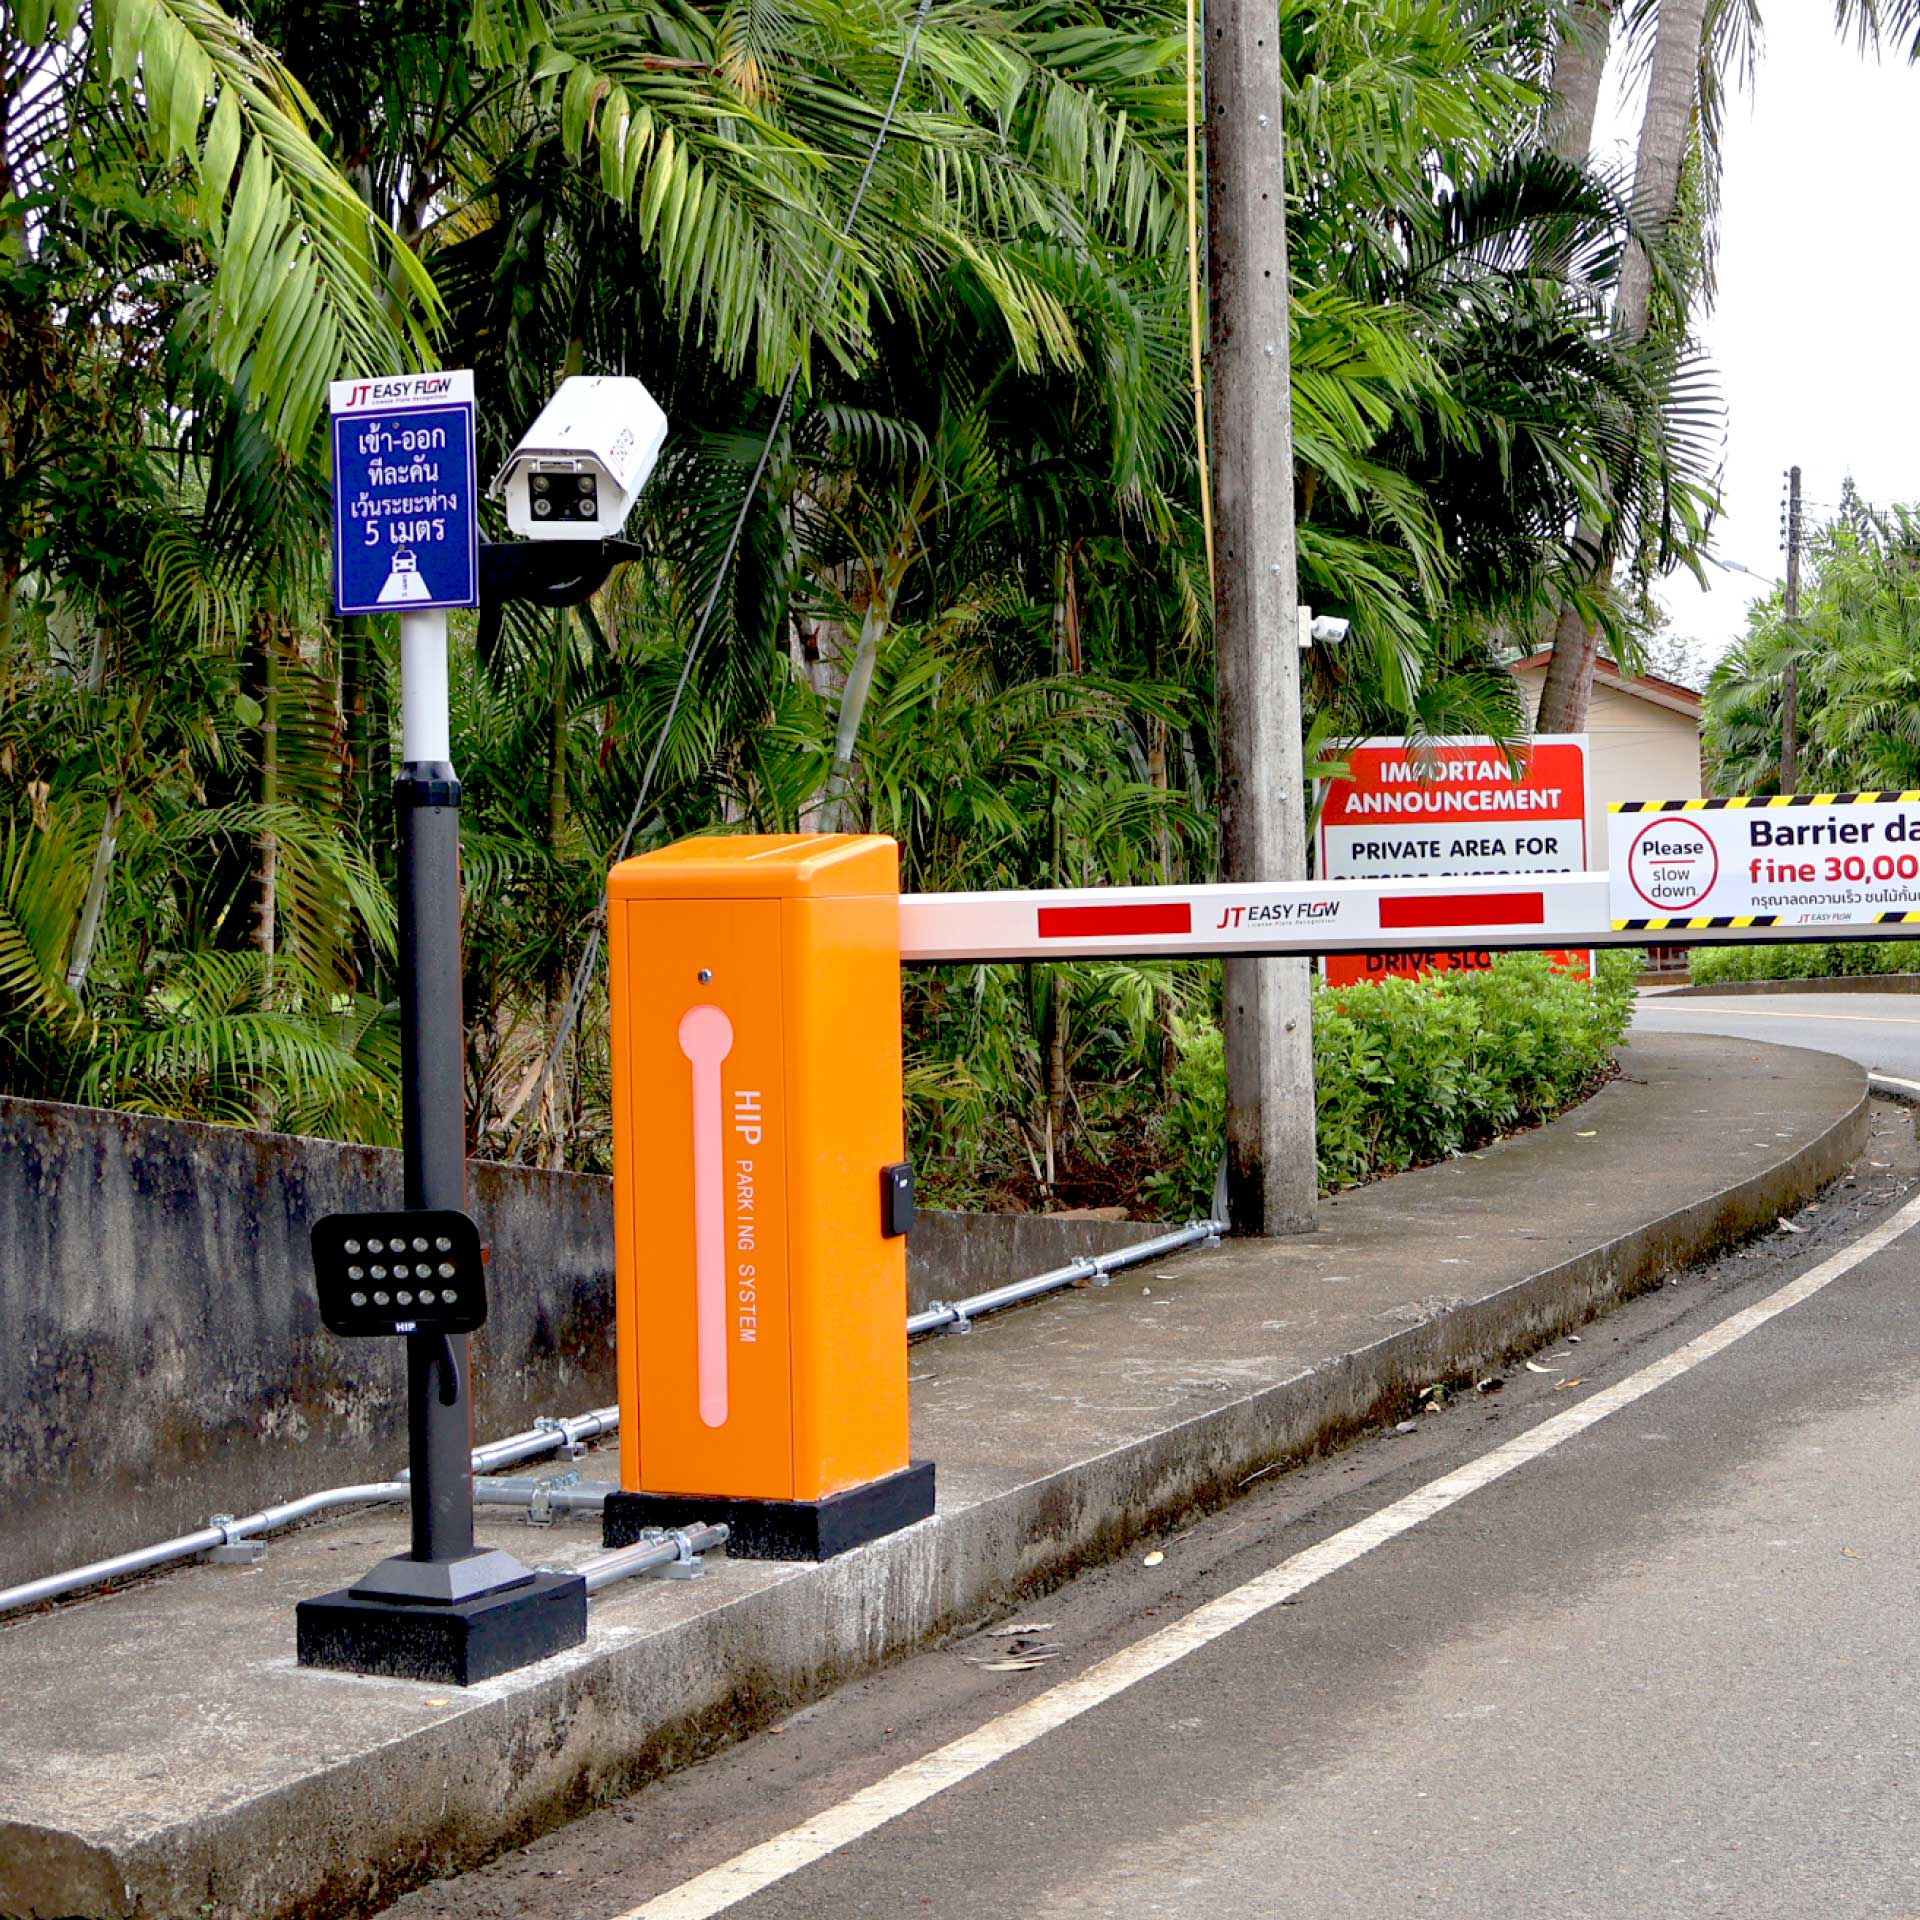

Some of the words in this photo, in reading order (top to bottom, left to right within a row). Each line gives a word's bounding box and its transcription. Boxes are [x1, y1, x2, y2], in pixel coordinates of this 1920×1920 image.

[345, 385, 372, 407] JT
[372, 381, 411, 398] EASY
[414, 378, 452, 394] FLOW
[359, 422, 446, 454] เข้า-ออก
[368, 454, 439, 486] ทีละคัน
[351, 488, 457, 518] เว้นระยะห่าง
[365, 520, 379, 546] 5
[390, 518, 445, 544] เมตร
[1345, 789, 1562, 814] ANNOUNCEMENT
[1750, 815, 1875, 848] Barrier
[1352, 840, 1441, 861] PRIVATE
[1449, 838, 1506, 857] AREA
[1515, 837, 1559, 855] FOR
[1642, 840, 1704, 856] Please
[1653, 867, 1690, 881] slow
[1750, 858, 1817, 884] fine
[1651, 883, 1696, 898] down
[1751, 889, 1862, 910] กรุณาลดความเร็ว
[1865, 885, 1920, 903] ชนไม้กั้น
[1216, 907, 1246, 929] JT
[1248, 904, 1294, 921] EASY
[1297, 900, 1341, 918] FLOW
[1447, 951, 1499, 969] SLO
[735, 1090, 762, 1145] HIP
[736, 1160, 755, 1251] PARKING
[738, 1264, 757, 1343] SYSTEM
[395, 1322, 416, 1333] HIP
